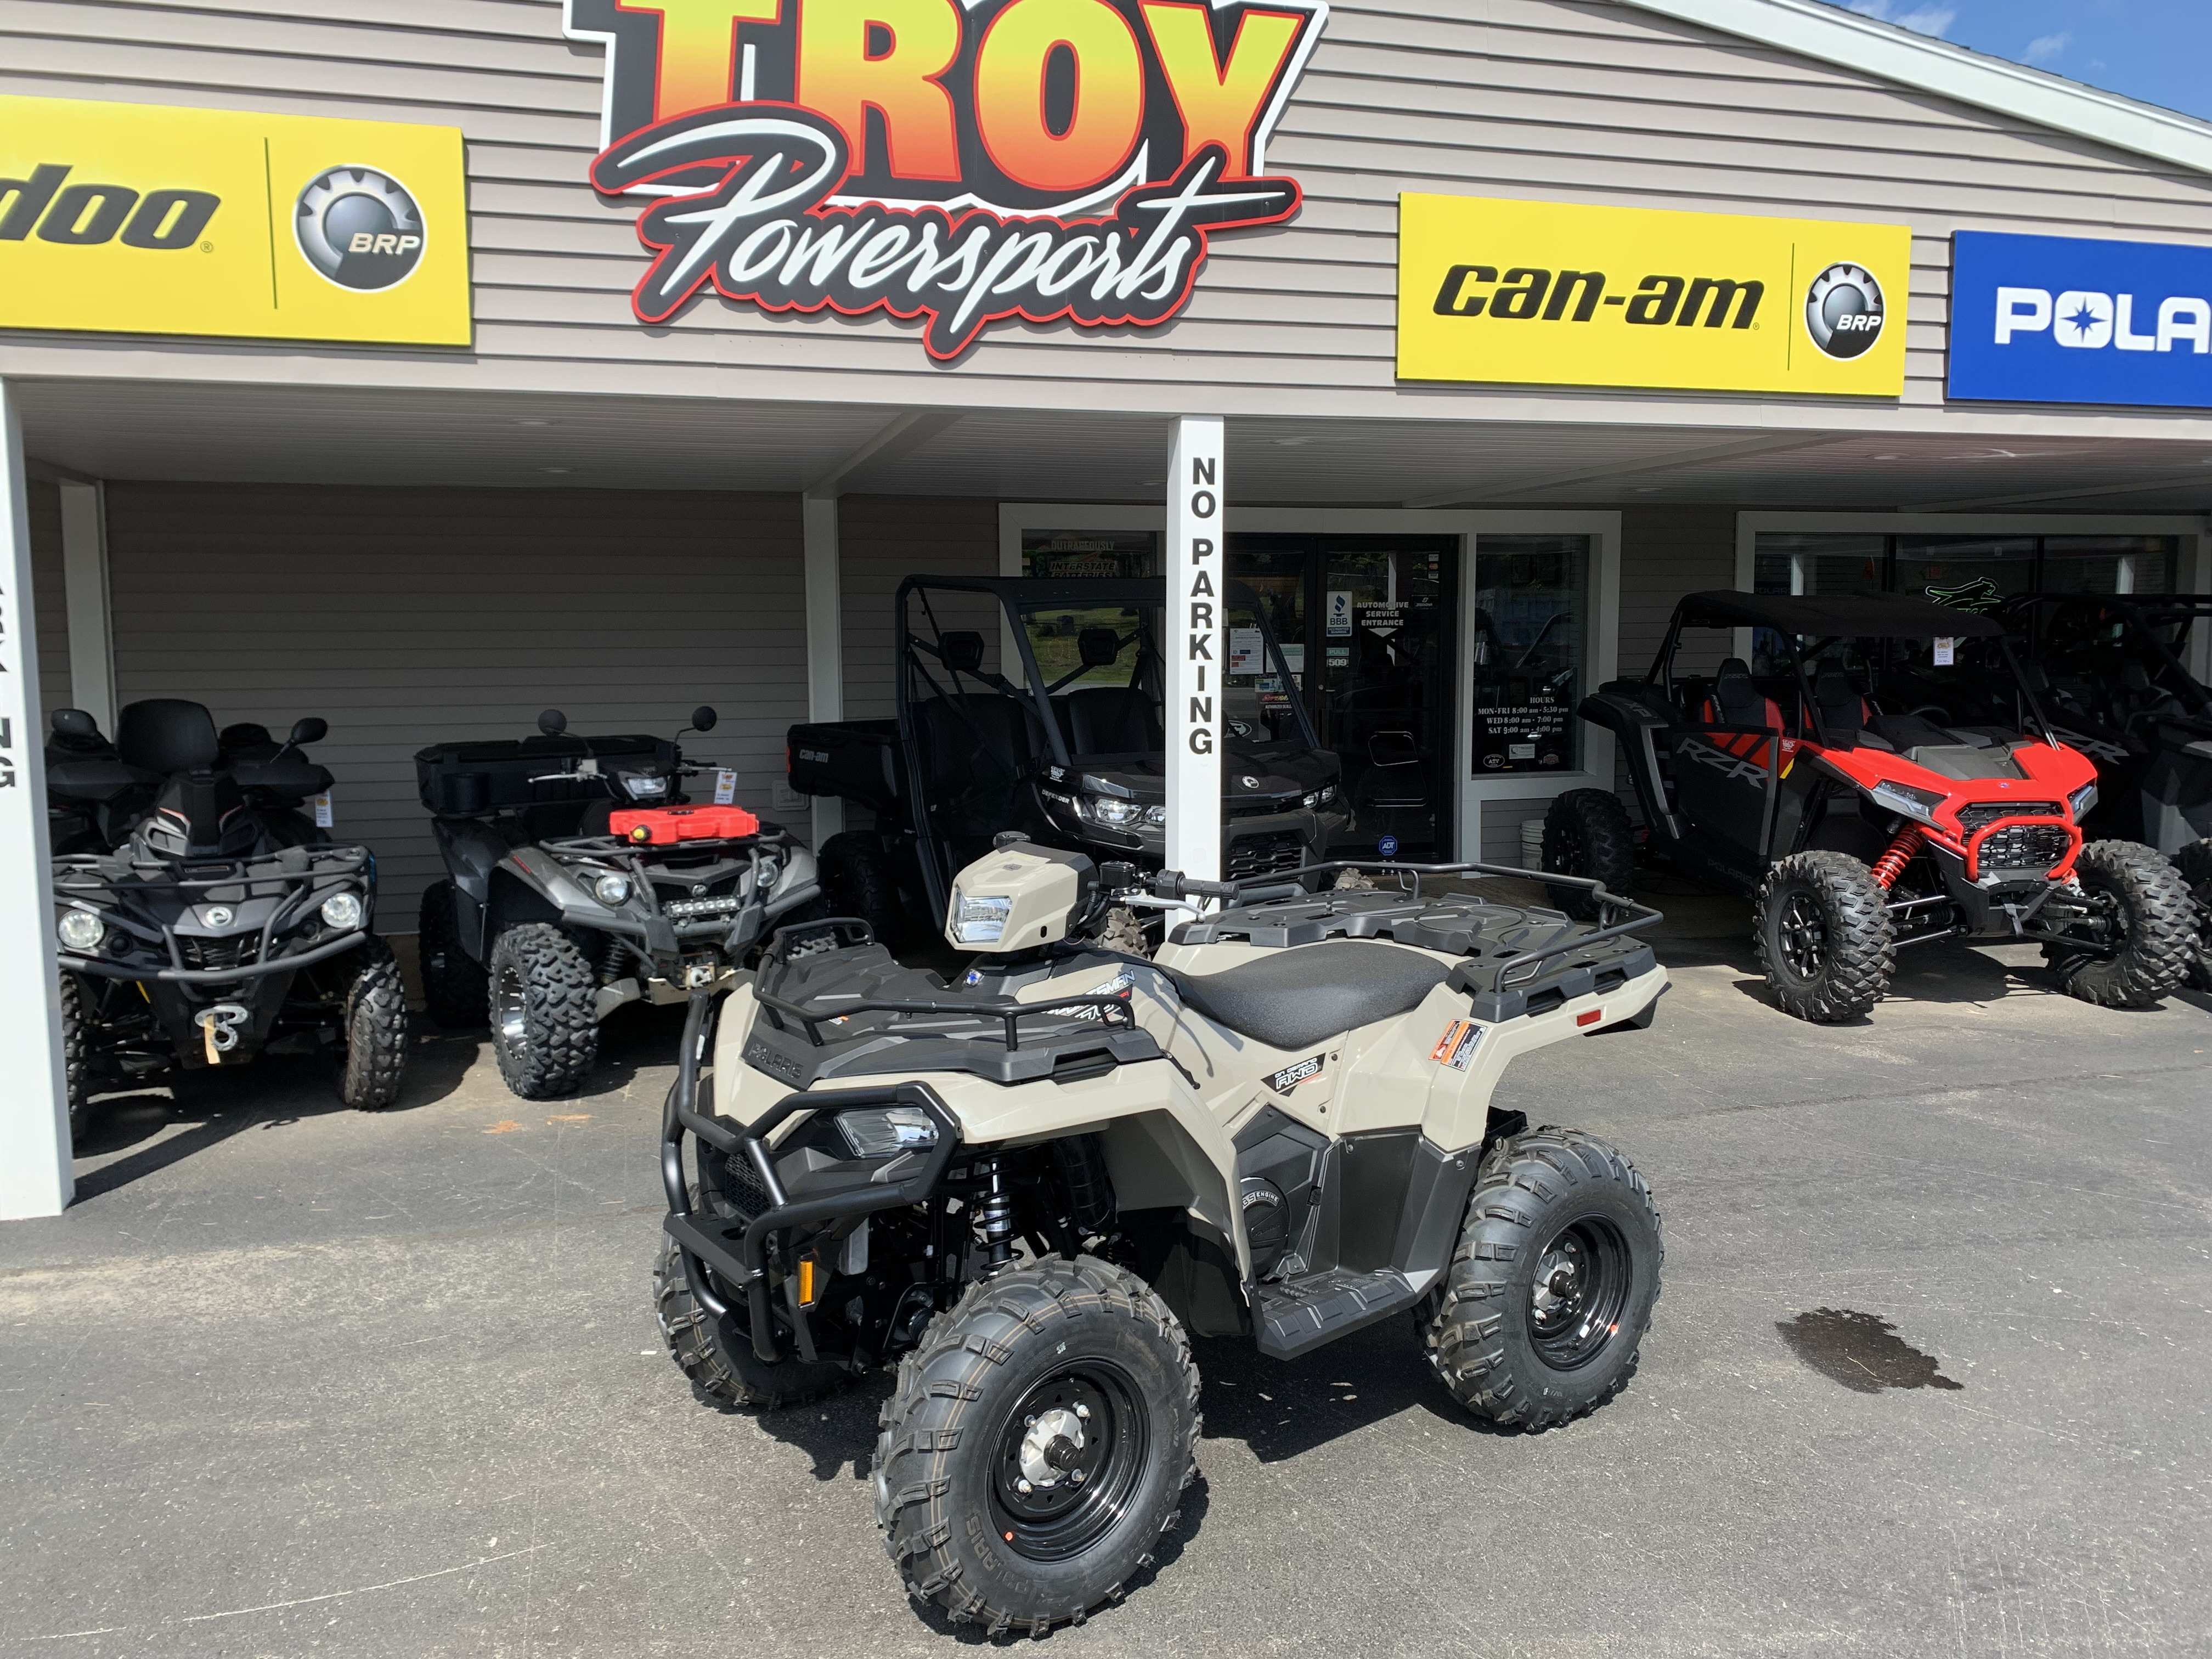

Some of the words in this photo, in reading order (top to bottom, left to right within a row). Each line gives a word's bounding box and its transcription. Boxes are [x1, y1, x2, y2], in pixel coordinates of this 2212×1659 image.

[614, 0, 1306, 191] TROY
[617, 115, 1287, 333] Powersports
[348, 232, 420, 256] BRP
[1433, 264, 1765, 329] can-am
[1836, 313, 1882, 331] BRP
[1191, 457, 1216, 519] NO
[1051, 562, 1115, 571] INTERSTATE
[1189, 538, 1215, 755] PARKING
[799, 748, 829, 763] can-am
[1676, 737, 1769, 789] RZR
[1042, 790, 1070, 804] DEFENDER
[748, 1043, 804, 1079] POLARIS
[1276, 1063, 1318, 1090] AWD
[1256, 1192, 1278, 1202] ENGINE
